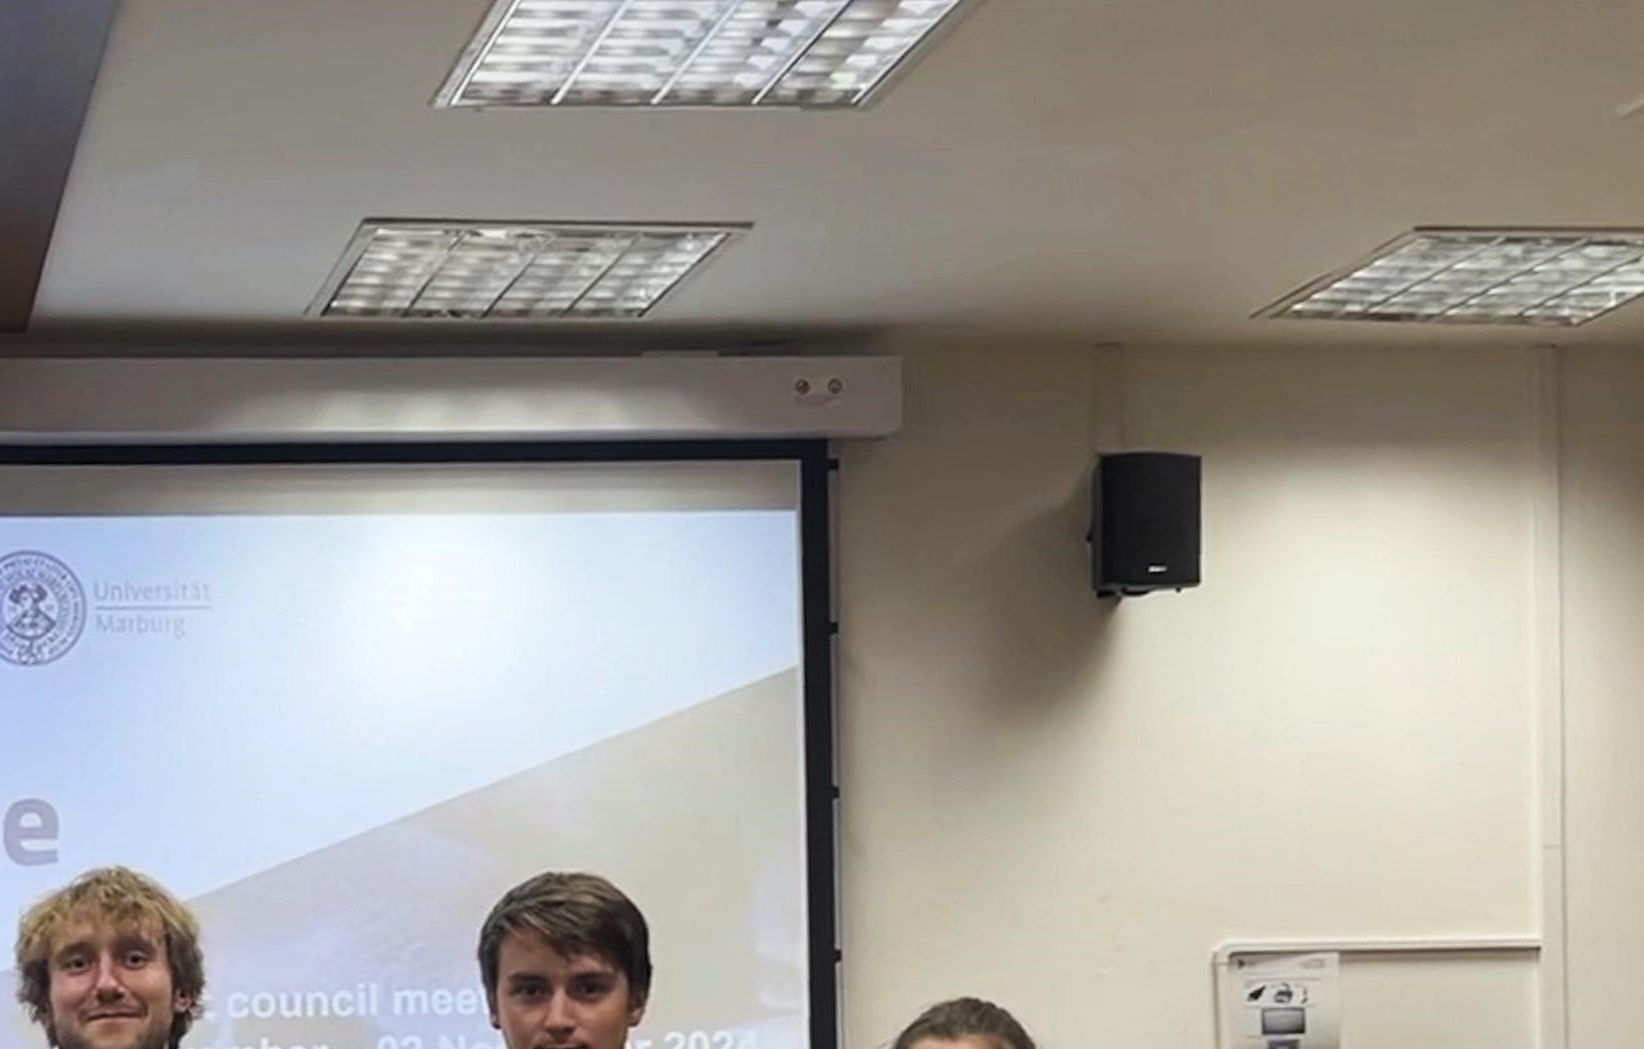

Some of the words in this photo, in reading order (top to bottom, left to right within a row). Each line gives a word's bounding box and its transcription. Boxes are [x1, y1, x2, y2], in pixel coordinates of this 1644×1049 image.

[93, 580, 212, 602] Universität
[95, 613, 186, 637] Marburg
[227, 983, 378, 1018] council
